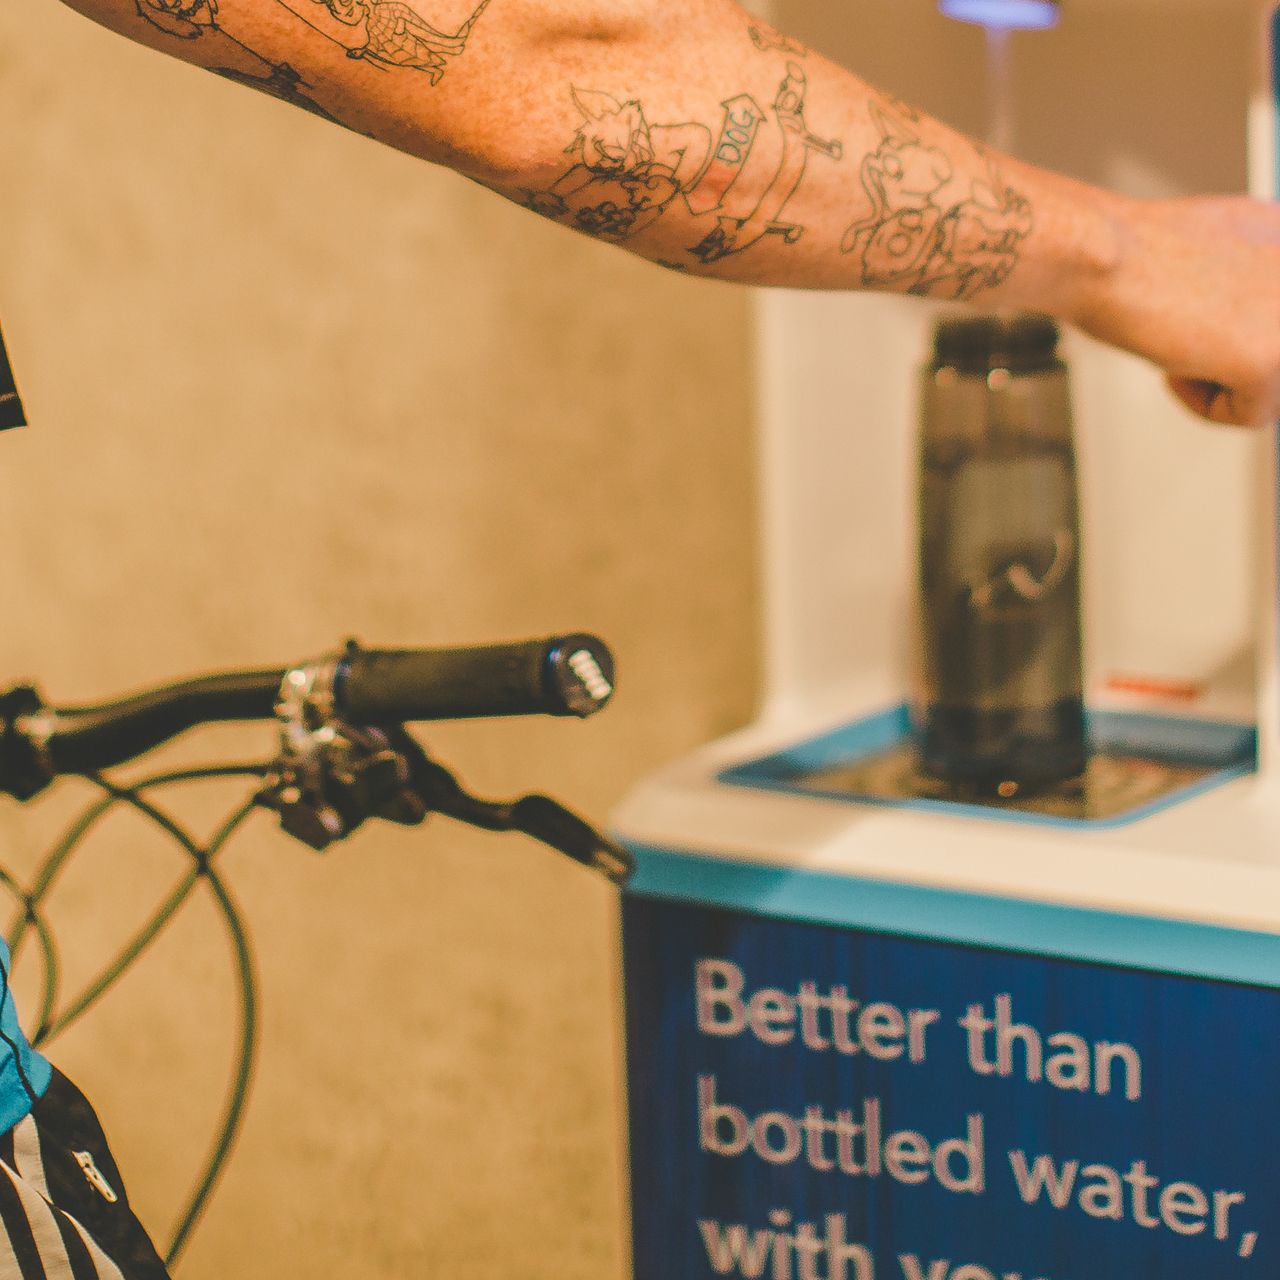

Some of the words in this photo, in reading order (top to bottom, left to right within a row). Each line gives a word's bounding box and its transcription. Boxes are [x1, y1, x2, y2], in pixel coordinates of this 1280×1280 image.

[716, 107, 754, 164] DOG
[695, 959, 940, 1063] Better
[960, 994, 1142, 1101] than
[698, 1074, 985, 1194] bottled
[1008, 1151, 1259, 1258] water,
[697, 1209, 876, 1280] with
